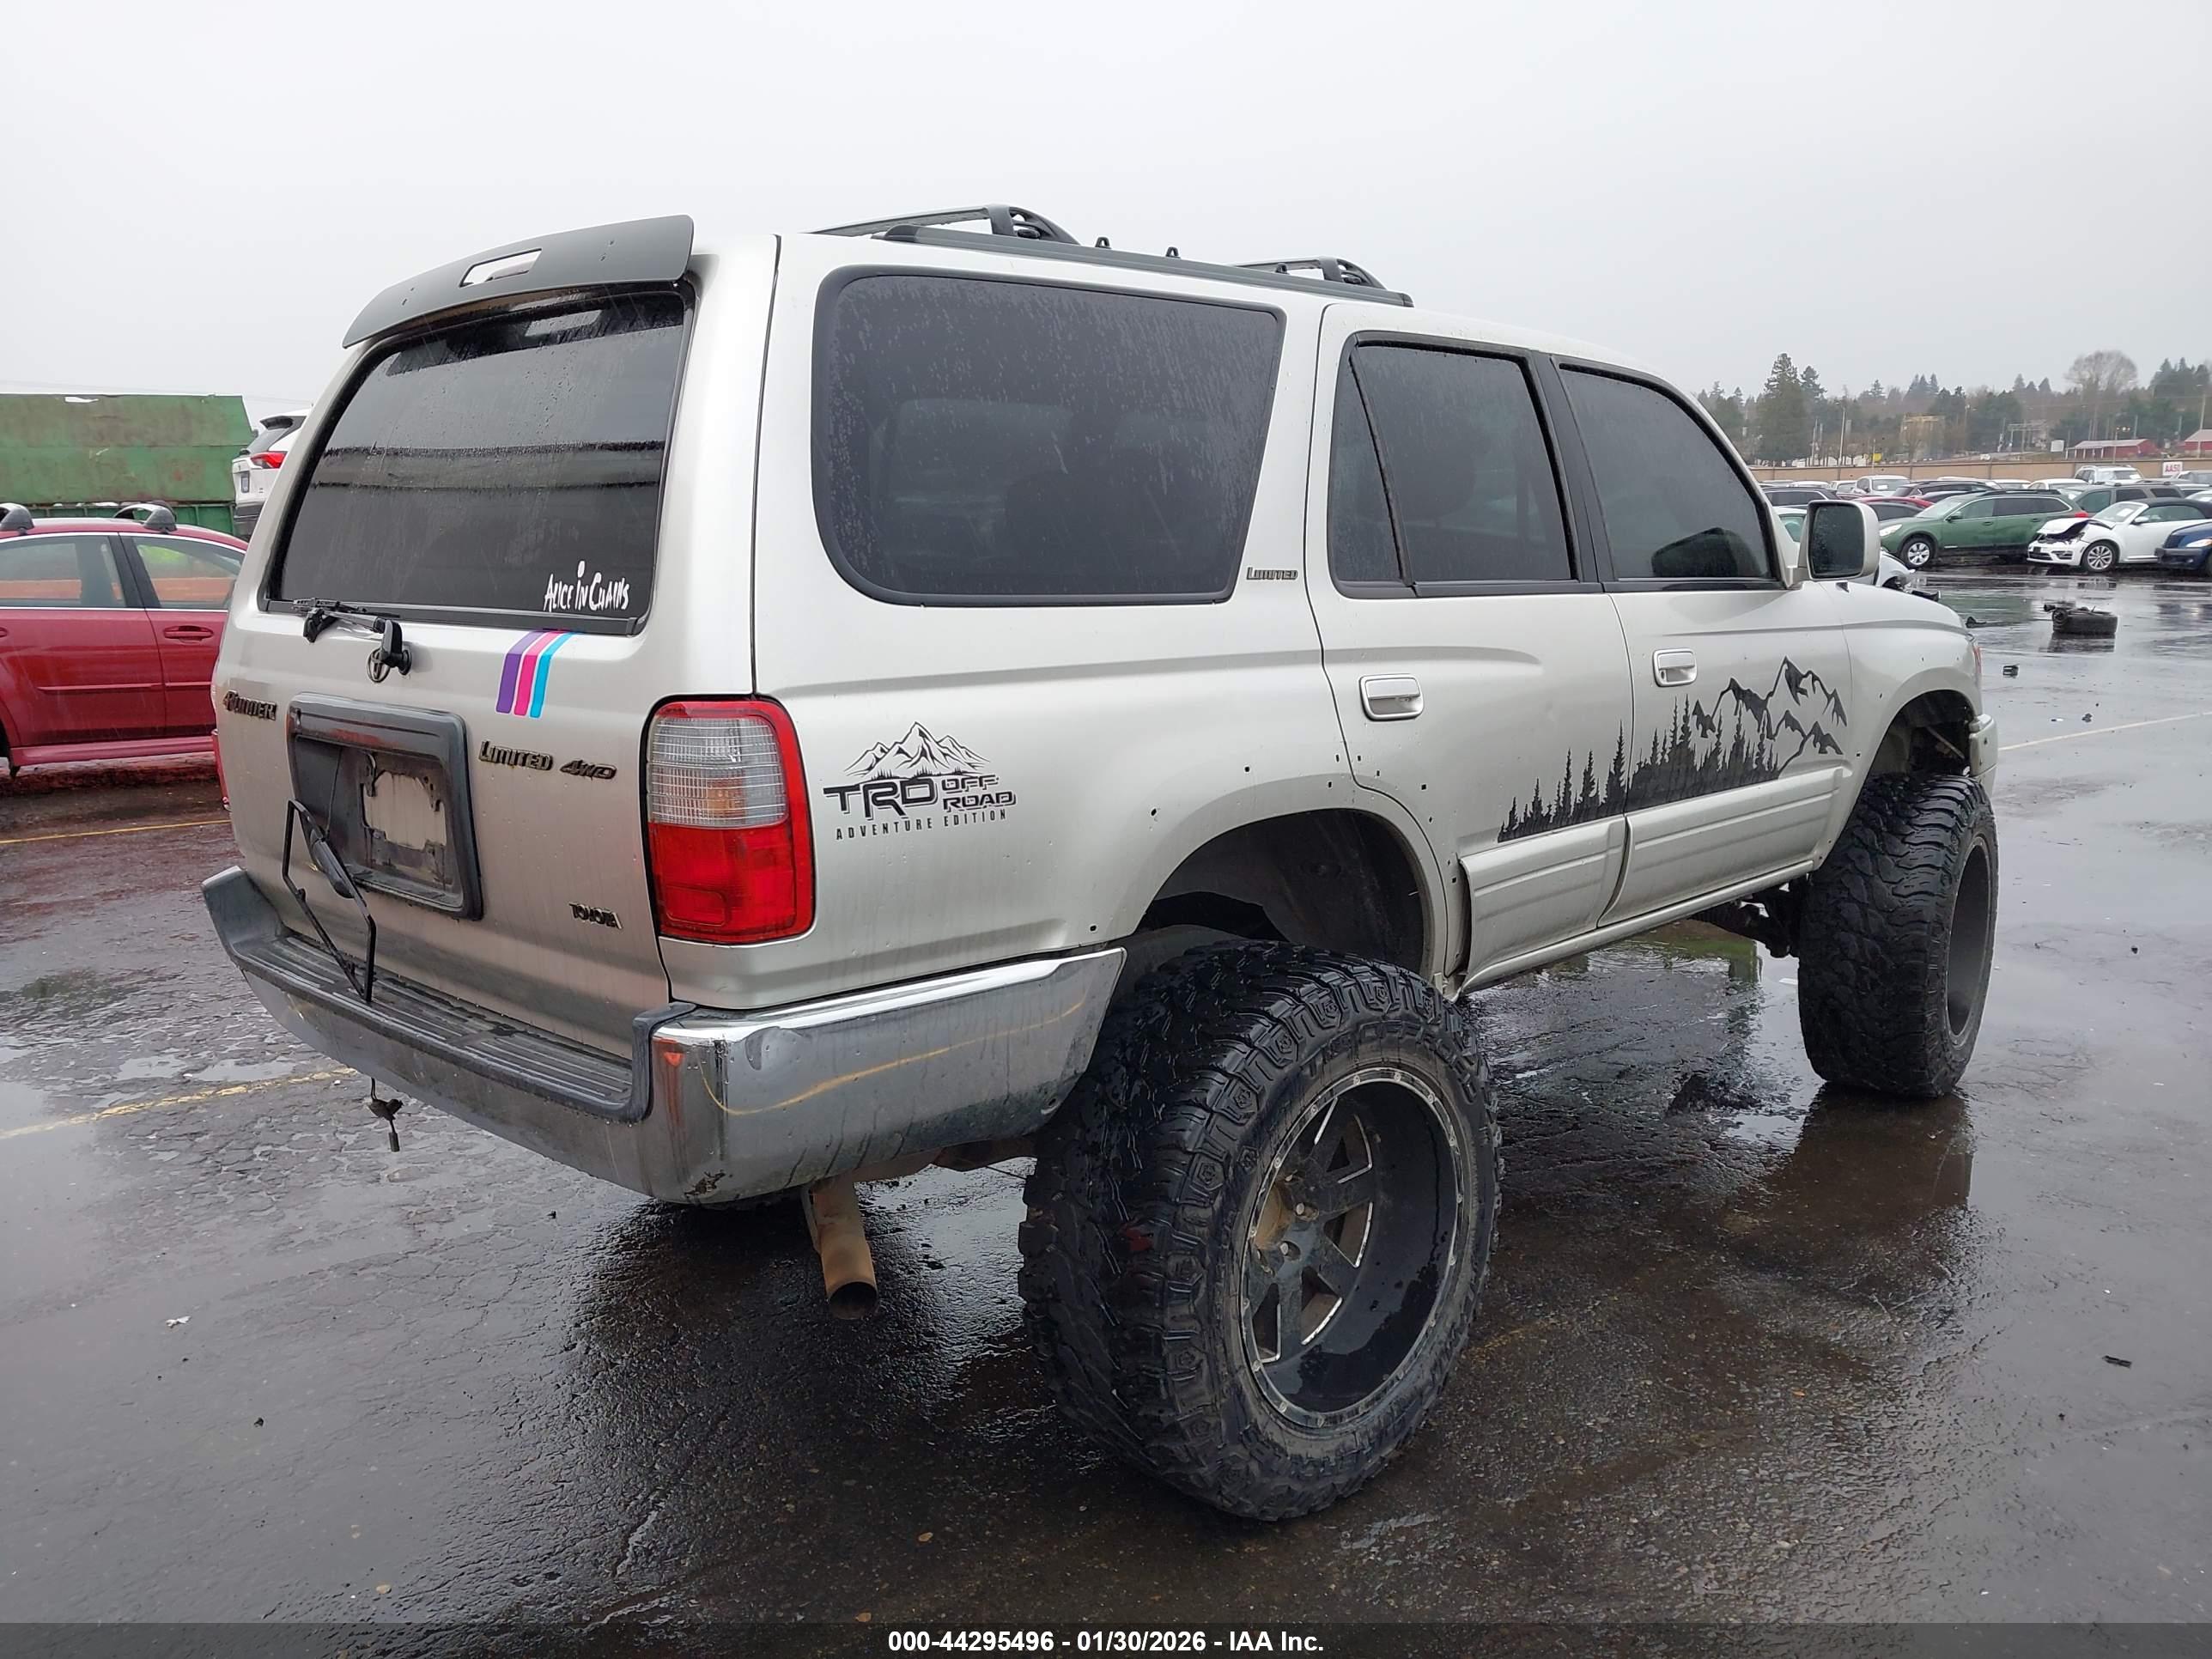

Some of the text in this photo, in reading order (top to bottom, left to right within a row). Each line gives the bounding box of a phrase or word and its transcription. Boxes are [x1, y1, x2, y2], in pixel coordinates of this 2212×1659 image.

[544, 574, 574, 612] ALICE
[589, 572, 629, 611] CHAINS
[559, 759, 617, 780] 4WD
[823, 774, 1000, 821] TRD OFF
[942, 791, 1017, 812] ROAD
[836, 809, 1006, 841] ADVENTURE EDITION
[568, 902, 623, 930] TOYOTA
